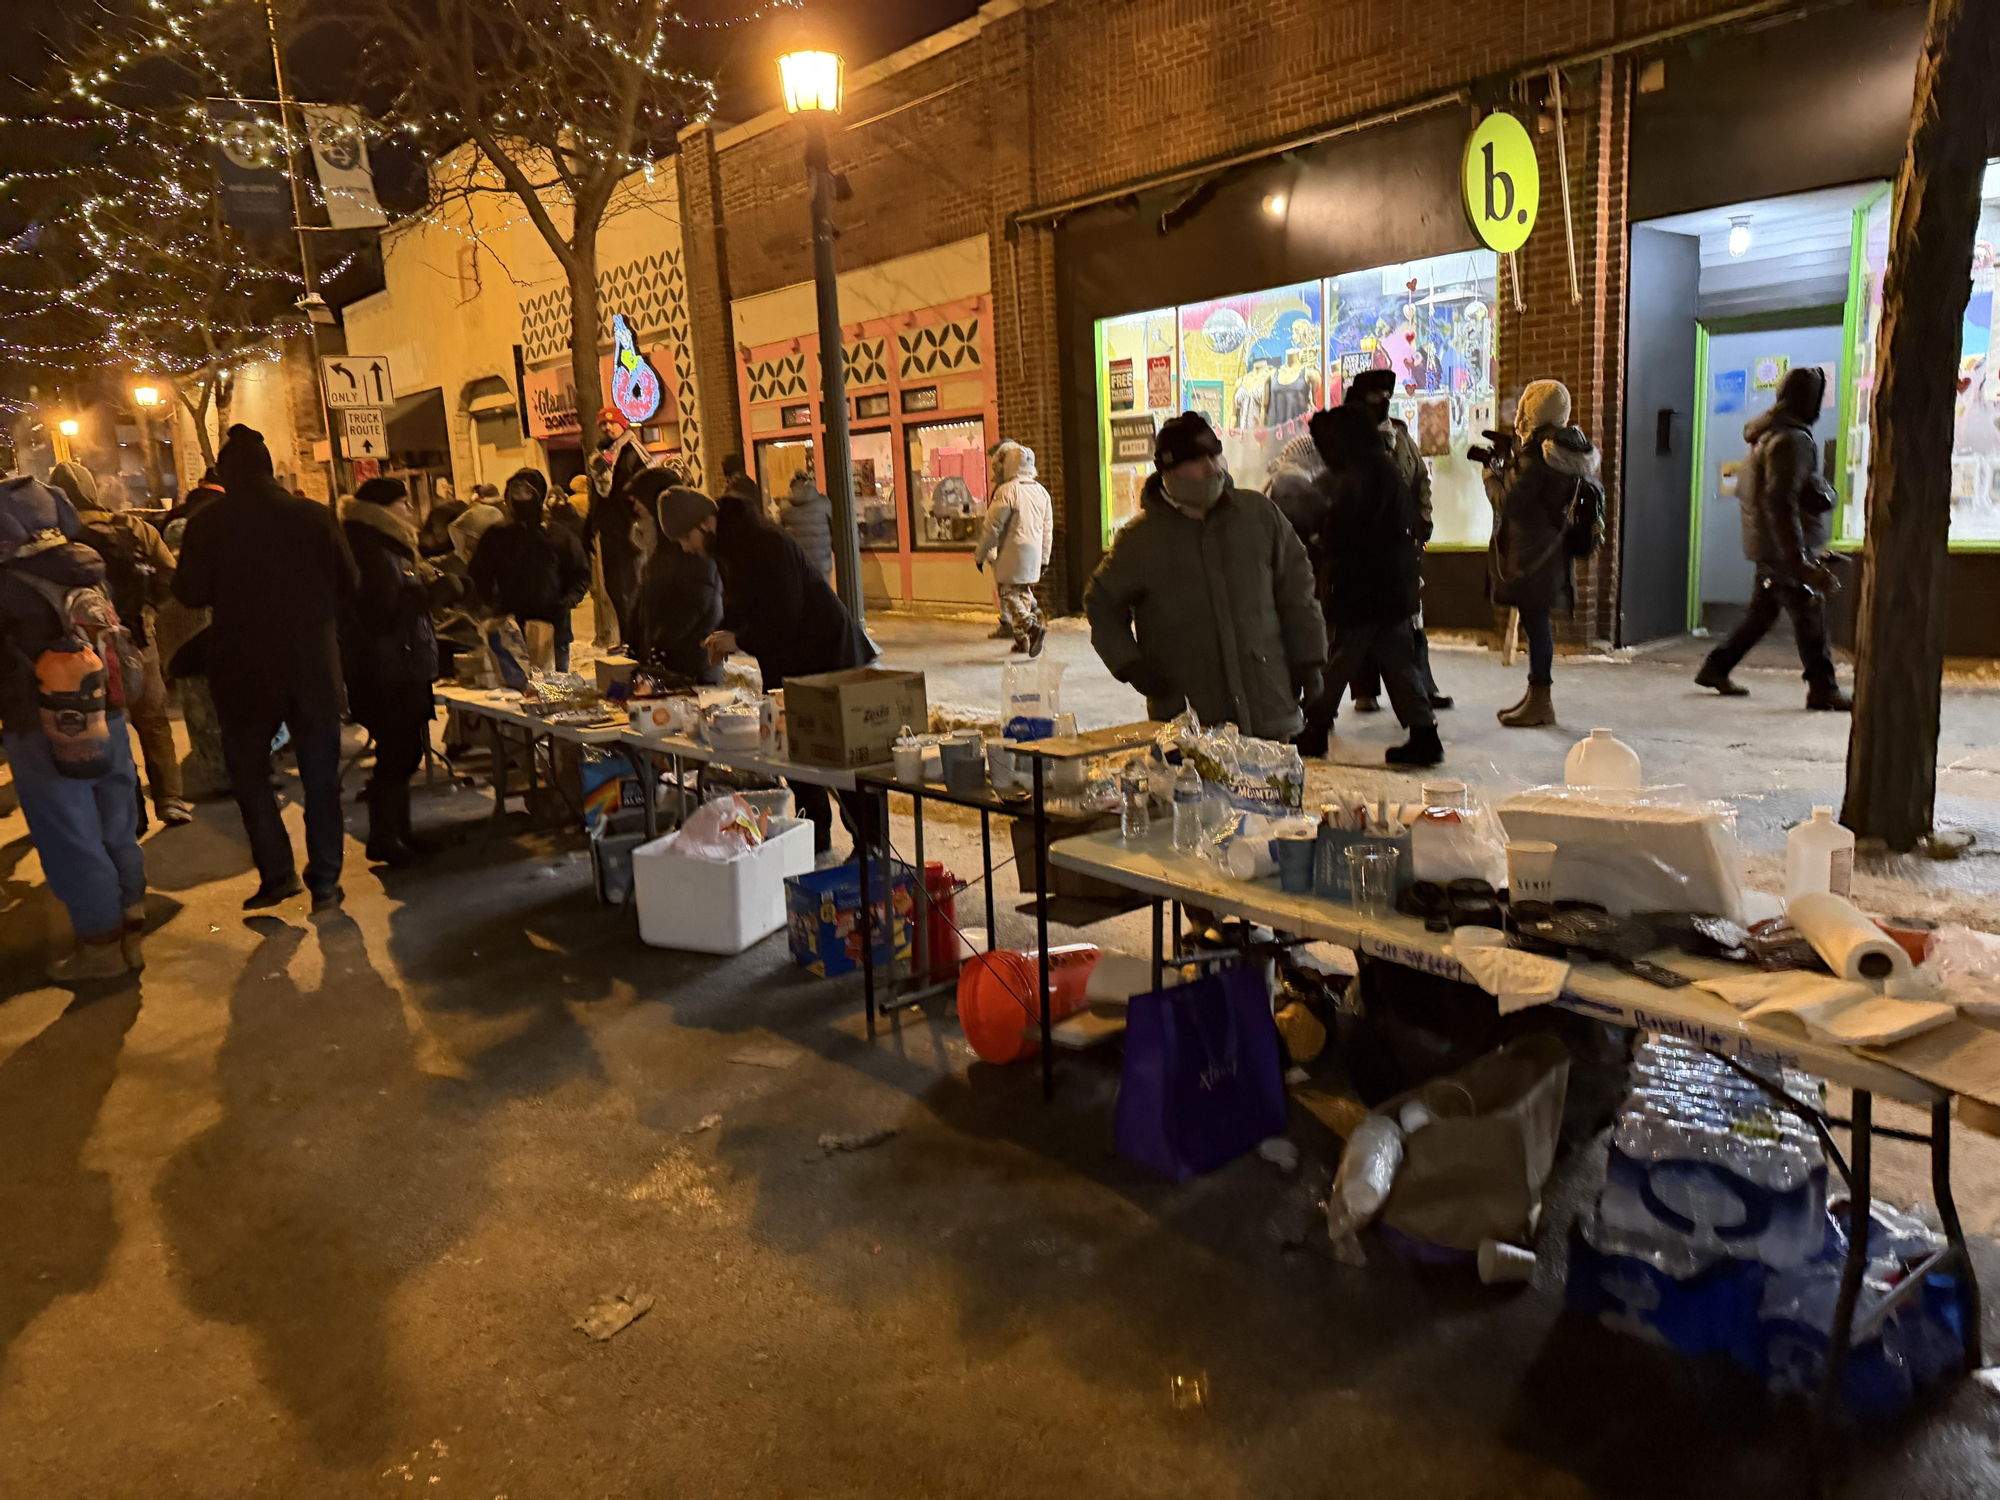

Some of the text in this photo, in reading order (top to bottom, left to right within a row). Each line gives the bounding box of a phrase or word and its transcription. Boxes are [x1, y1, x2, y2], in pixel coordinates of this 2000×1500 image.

[1481, 141, 1528, 225] b.
[1111, 373, 1133, 389] FREE
[331, 392, 358, 403] ONLY
[348, 413, 380, 423] TRUCK
[350, 425, 381, 435] ROUTE
[1113, 423, 1154, 437] BLACK LIVES
[1121, 442, 1146, 453] MATTER
